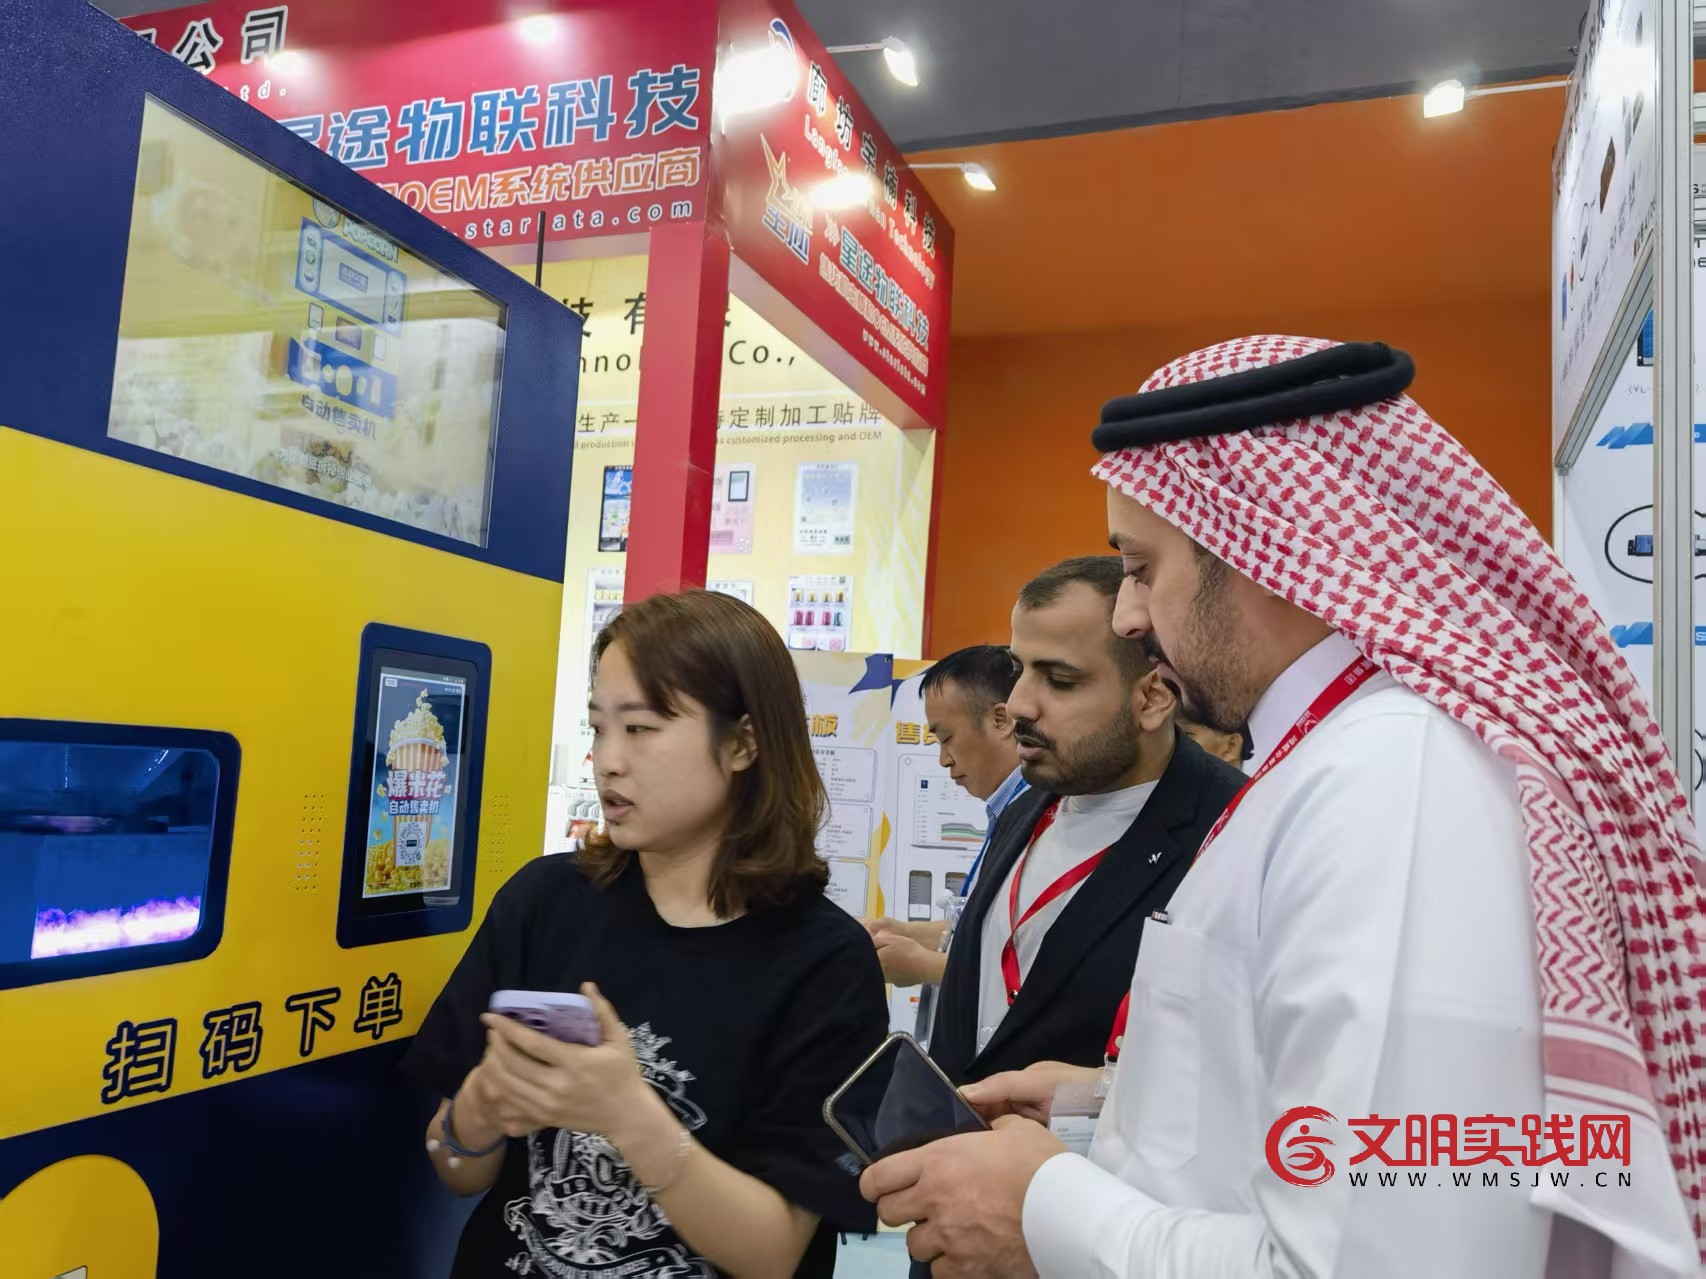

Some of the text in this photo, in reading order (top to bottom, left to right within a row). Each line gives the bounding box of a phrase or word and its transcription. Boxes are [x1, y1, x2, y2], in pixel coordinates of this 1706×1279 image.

[138, 6, 289, 75] 公司
[302, 394, 376, 440] 自动售卖机
[726, 433, 780, 445] customized
[783, 433, 835, 446] processing
[838, 431, 856, 441] and
[859, 430, 882, 441] OEM
[386, 769, 447, 798] 爆米花
[389, 799, 440, 815] 自动售卖机
[101, 972, 403, 1104] 扫码下单
